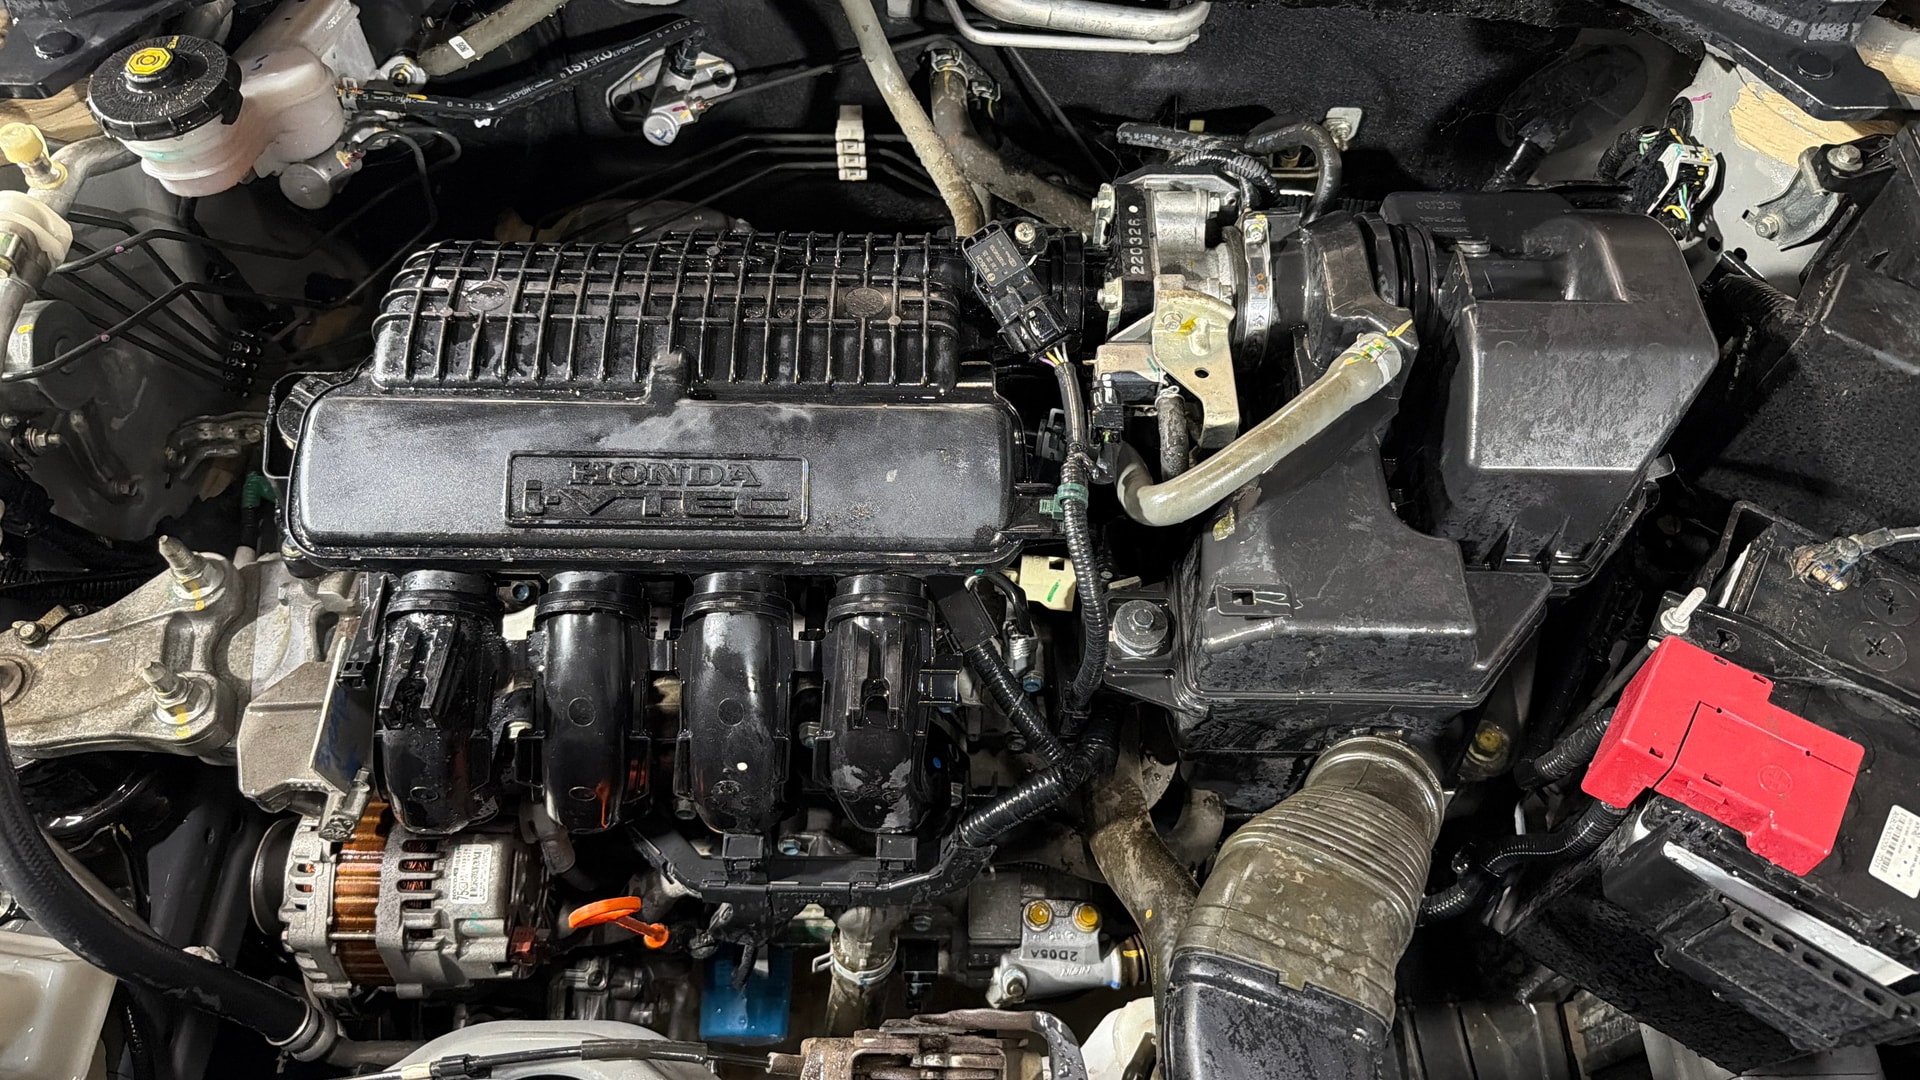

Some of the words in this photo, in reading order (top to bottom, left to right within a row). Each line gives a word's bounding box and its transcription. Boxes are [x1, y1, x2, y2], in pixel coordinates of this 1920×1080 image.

[1128, 218, 1145, 275] 220326
[975, 254, 991, 274] BOSCH
[568, 460, 762, 488] HONDA
[522, 479, 790, 519] i-VTEC
[1030, 948, 1079, 962] 2D05A
